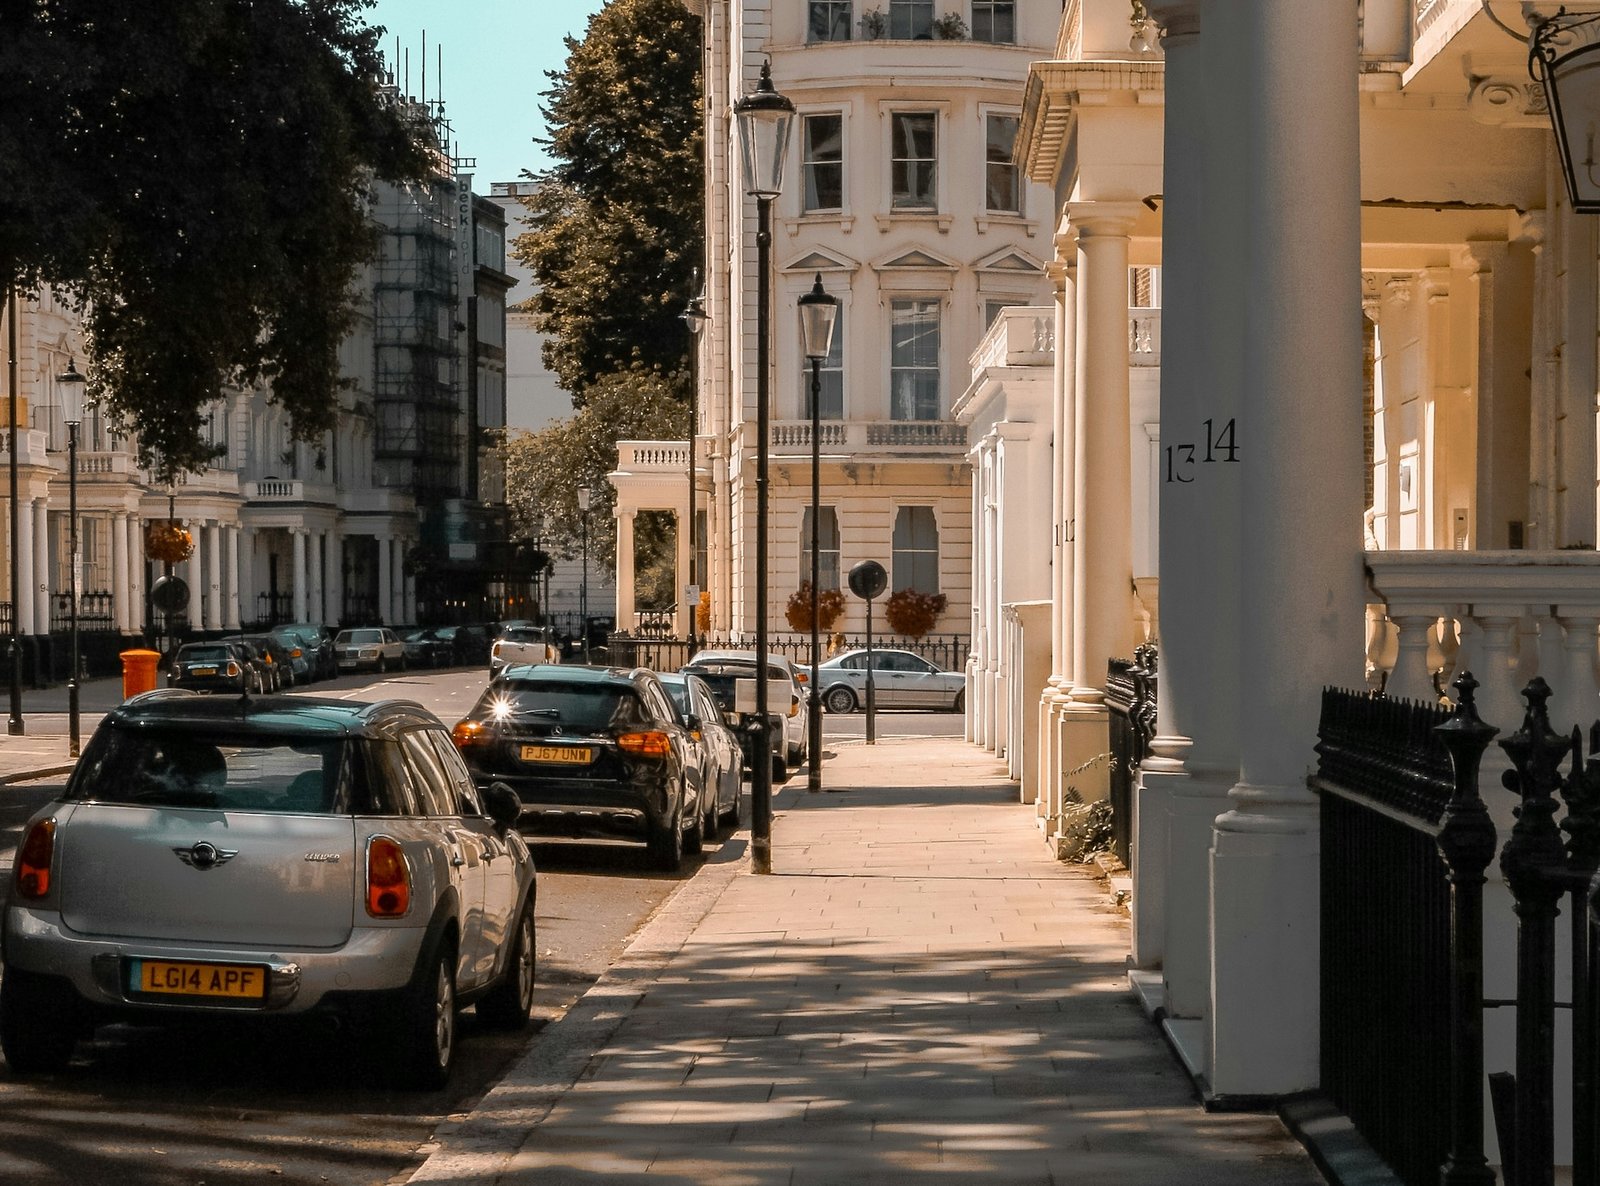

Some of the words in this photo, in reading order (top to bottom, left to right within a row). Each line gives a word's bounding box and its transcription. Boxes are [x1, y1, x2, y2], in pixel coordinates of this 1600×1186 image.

[1202, 418, 1240, 462] 14
[1165, 444, 1195, 483] 13
[526, 747, 559, 760] PJ67
[561, 749, 586, 761] UNW
[150, 966, 202, 990] LG14
[209, 969, 254, 993] APF
